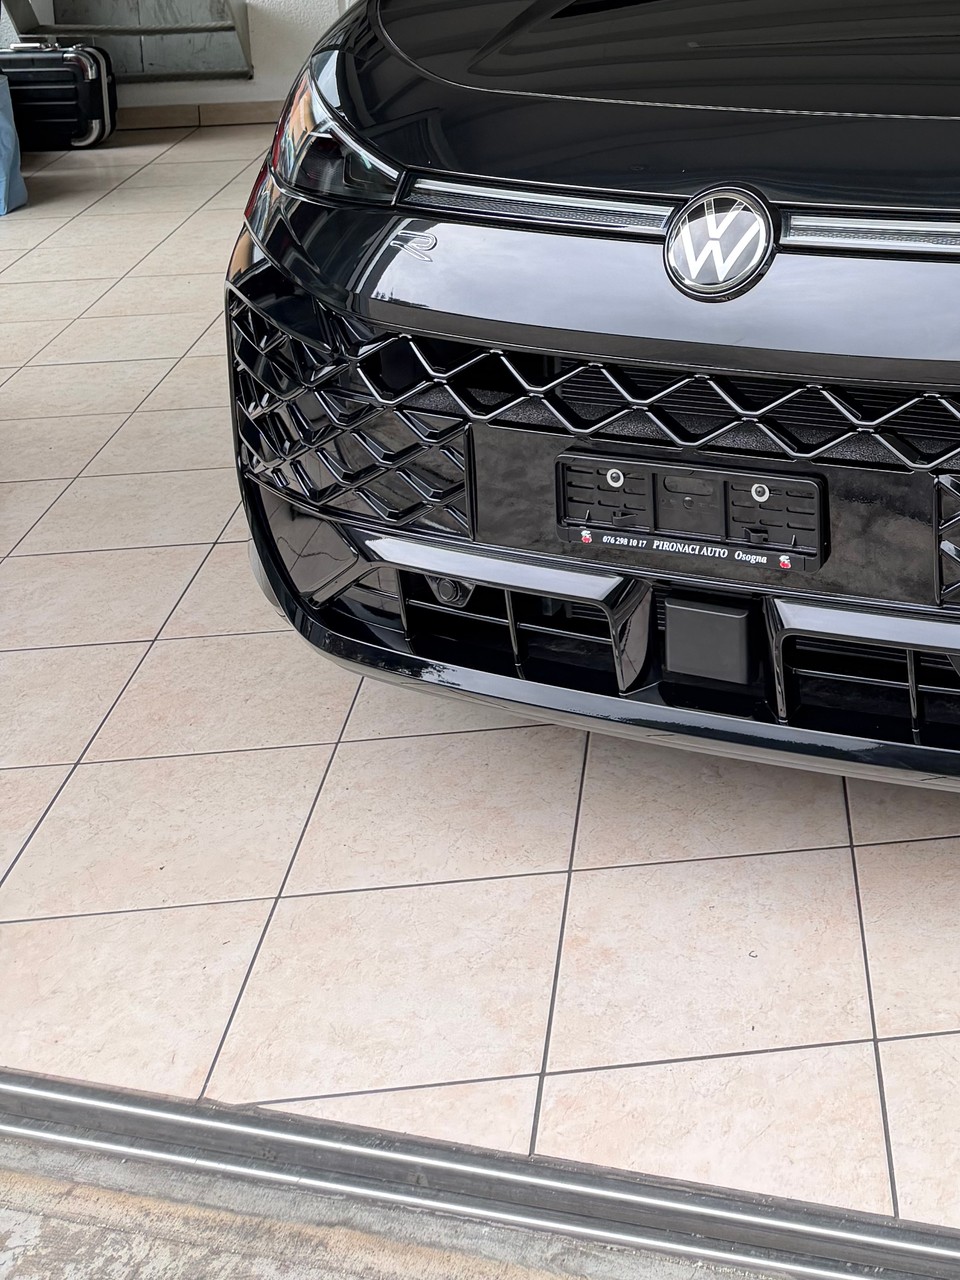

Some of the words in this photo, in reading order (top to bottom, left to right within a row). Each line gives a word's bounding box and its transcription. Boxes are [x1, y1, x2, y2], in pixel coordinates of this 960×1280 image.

[676, 196, 763, 283] VW
[602, 535, 615, 544] 076
[615, 537, 628, 546] 298
[629, 538, 638, 547] 10
[638, 540, 647, 548] 17
[652, 540, 700, 555] PIRONACI
[700, 546, 729, 558] AUTO
[734, 550, 768, 564] Osogna
